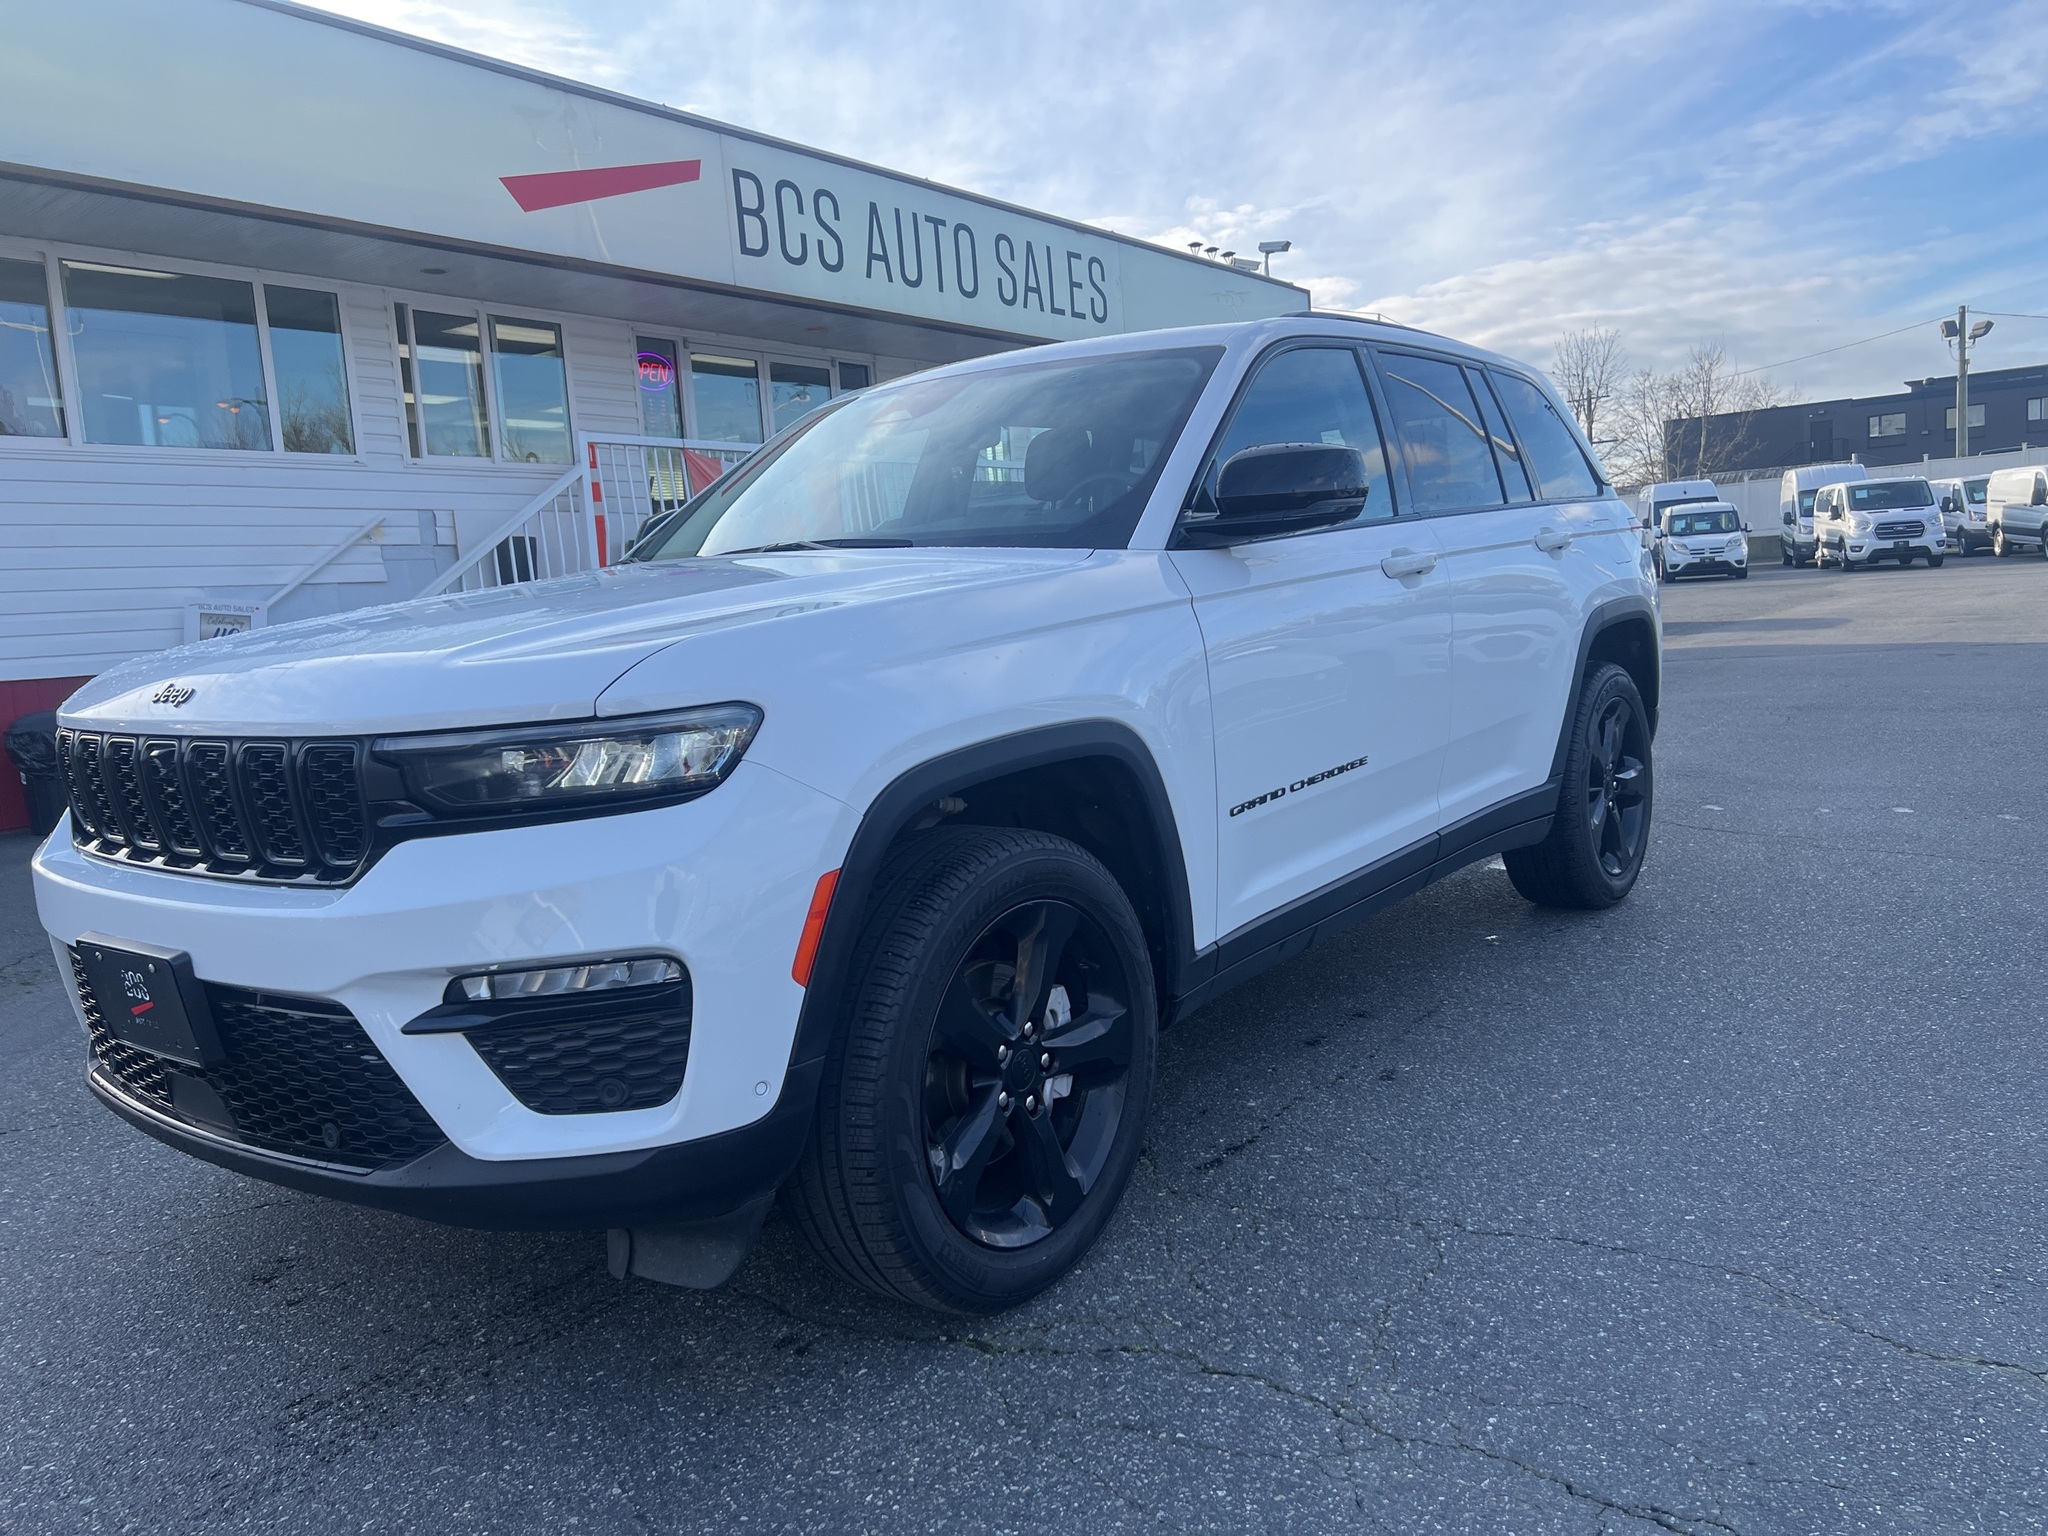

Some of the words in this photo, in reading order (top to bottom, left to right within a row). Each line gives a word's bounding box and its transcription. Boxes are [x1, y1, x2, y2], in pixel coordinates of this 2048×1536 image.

[731, 168, 844, 273] BCS
[866, 201, 979, 299] AUTO
[994, 233, 1108, 324] SALES
[638, 362, 669, 383] PEN
[198, 603, 213, 611] BCS
[213, 604, 232, 612] AUTO
[232, 606, 255, 614] SALES
[152, 683, 196, 708] Jeep
[1229, 787, 1286, 817] GRAND
[1289, 755, 1369, 793] CHEROKEE
